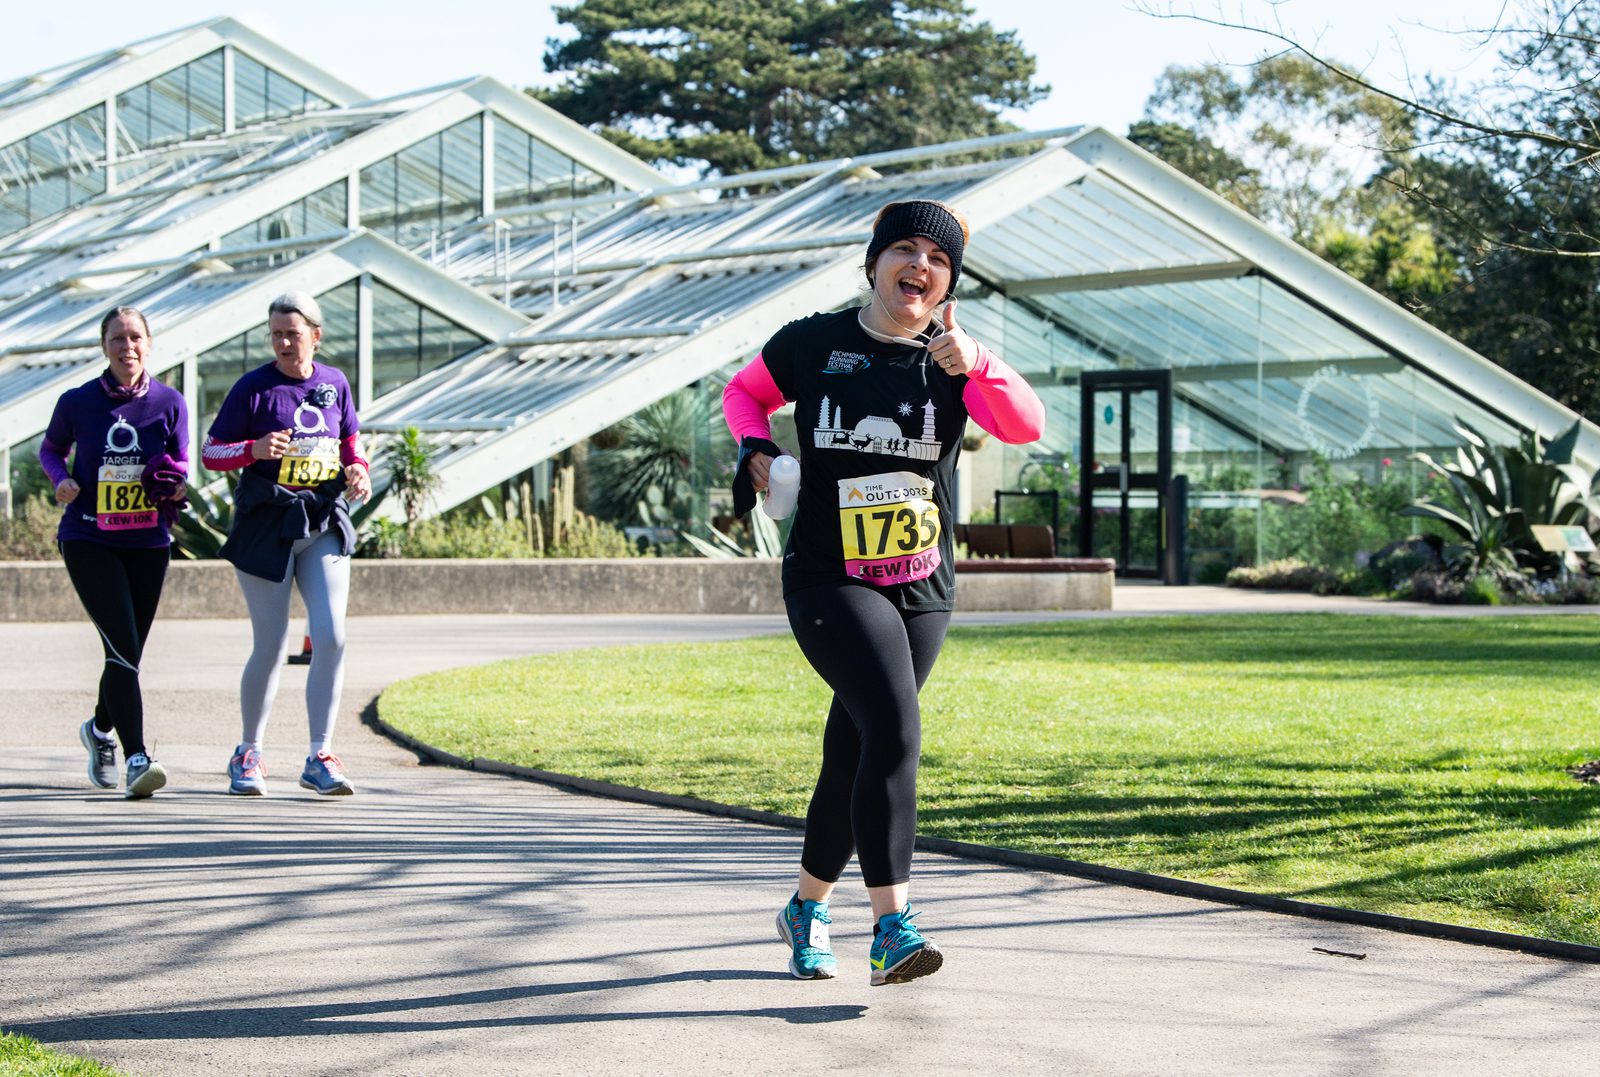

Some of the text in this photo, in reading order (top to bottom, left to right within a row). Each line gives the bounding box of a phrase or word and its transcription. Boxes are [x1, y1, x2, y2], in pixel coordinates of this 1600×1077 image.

[829, 355, 859, 365] RUNNING
[831, 350, 866, 360] RICHMOND
[827, 361, 854, 371] FESTIVAL
[102, 456, 141, 466] TARGET
[866, 487, 928, 502] OUTDOORS
[105, 514, 153, 525] KEW 10K
[855, 506, 937, 555] 1735
[860, 553, 935, 578] KEW 10K
